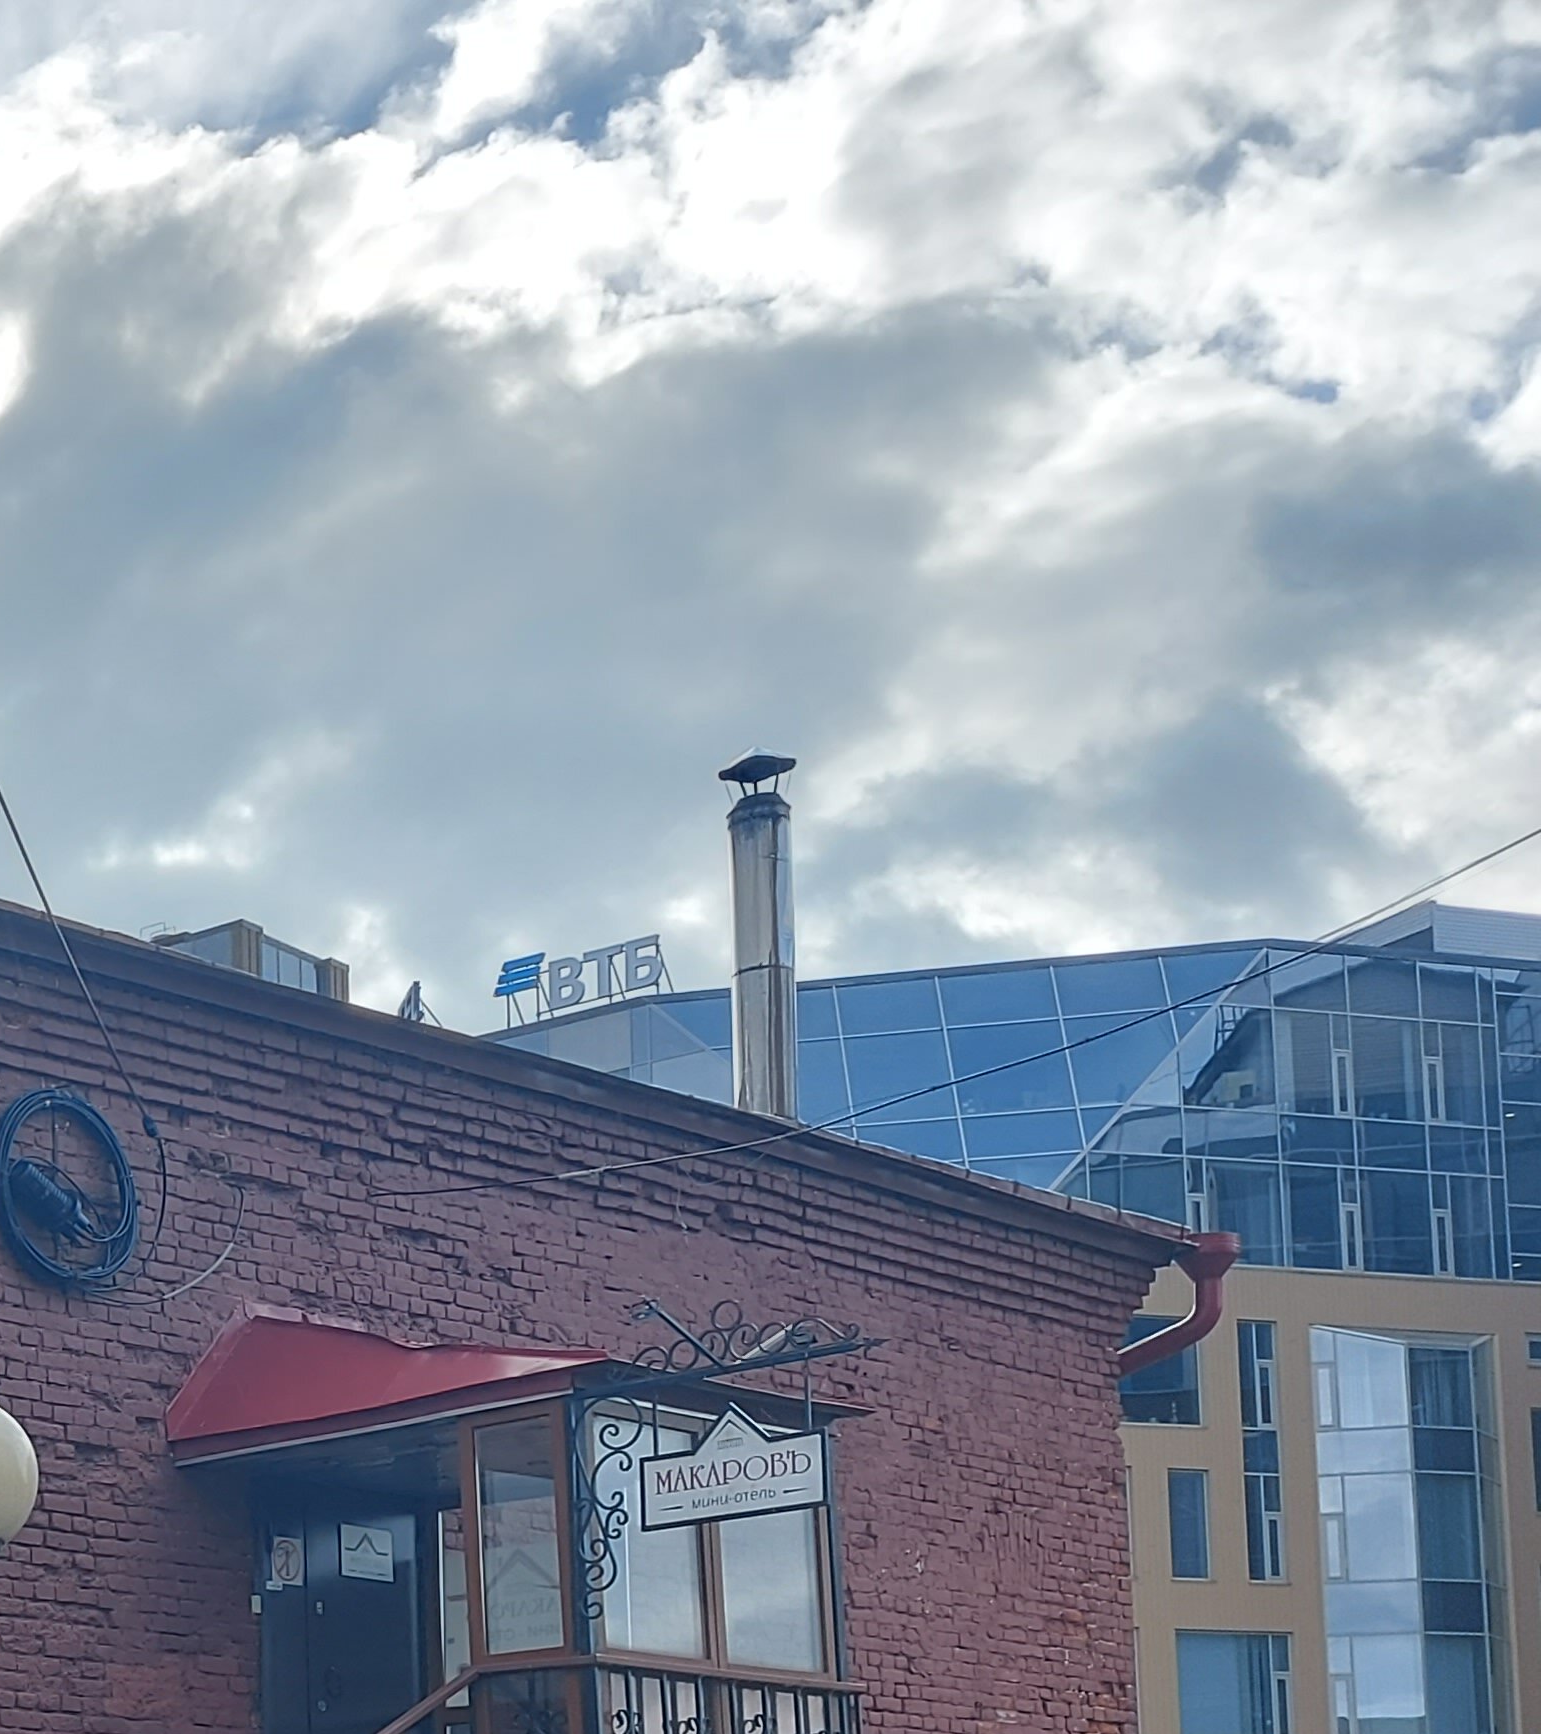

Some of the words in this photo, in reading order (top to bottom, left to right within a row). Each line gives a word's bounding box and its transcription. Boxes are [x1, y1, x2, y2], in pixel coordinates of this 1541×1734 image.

[548, 934, 662, 1009] ВТБ
[655, 1450, 812, 1495] МАКАРОВЪ
[691, 1488, 777, 1510] мини-отель
